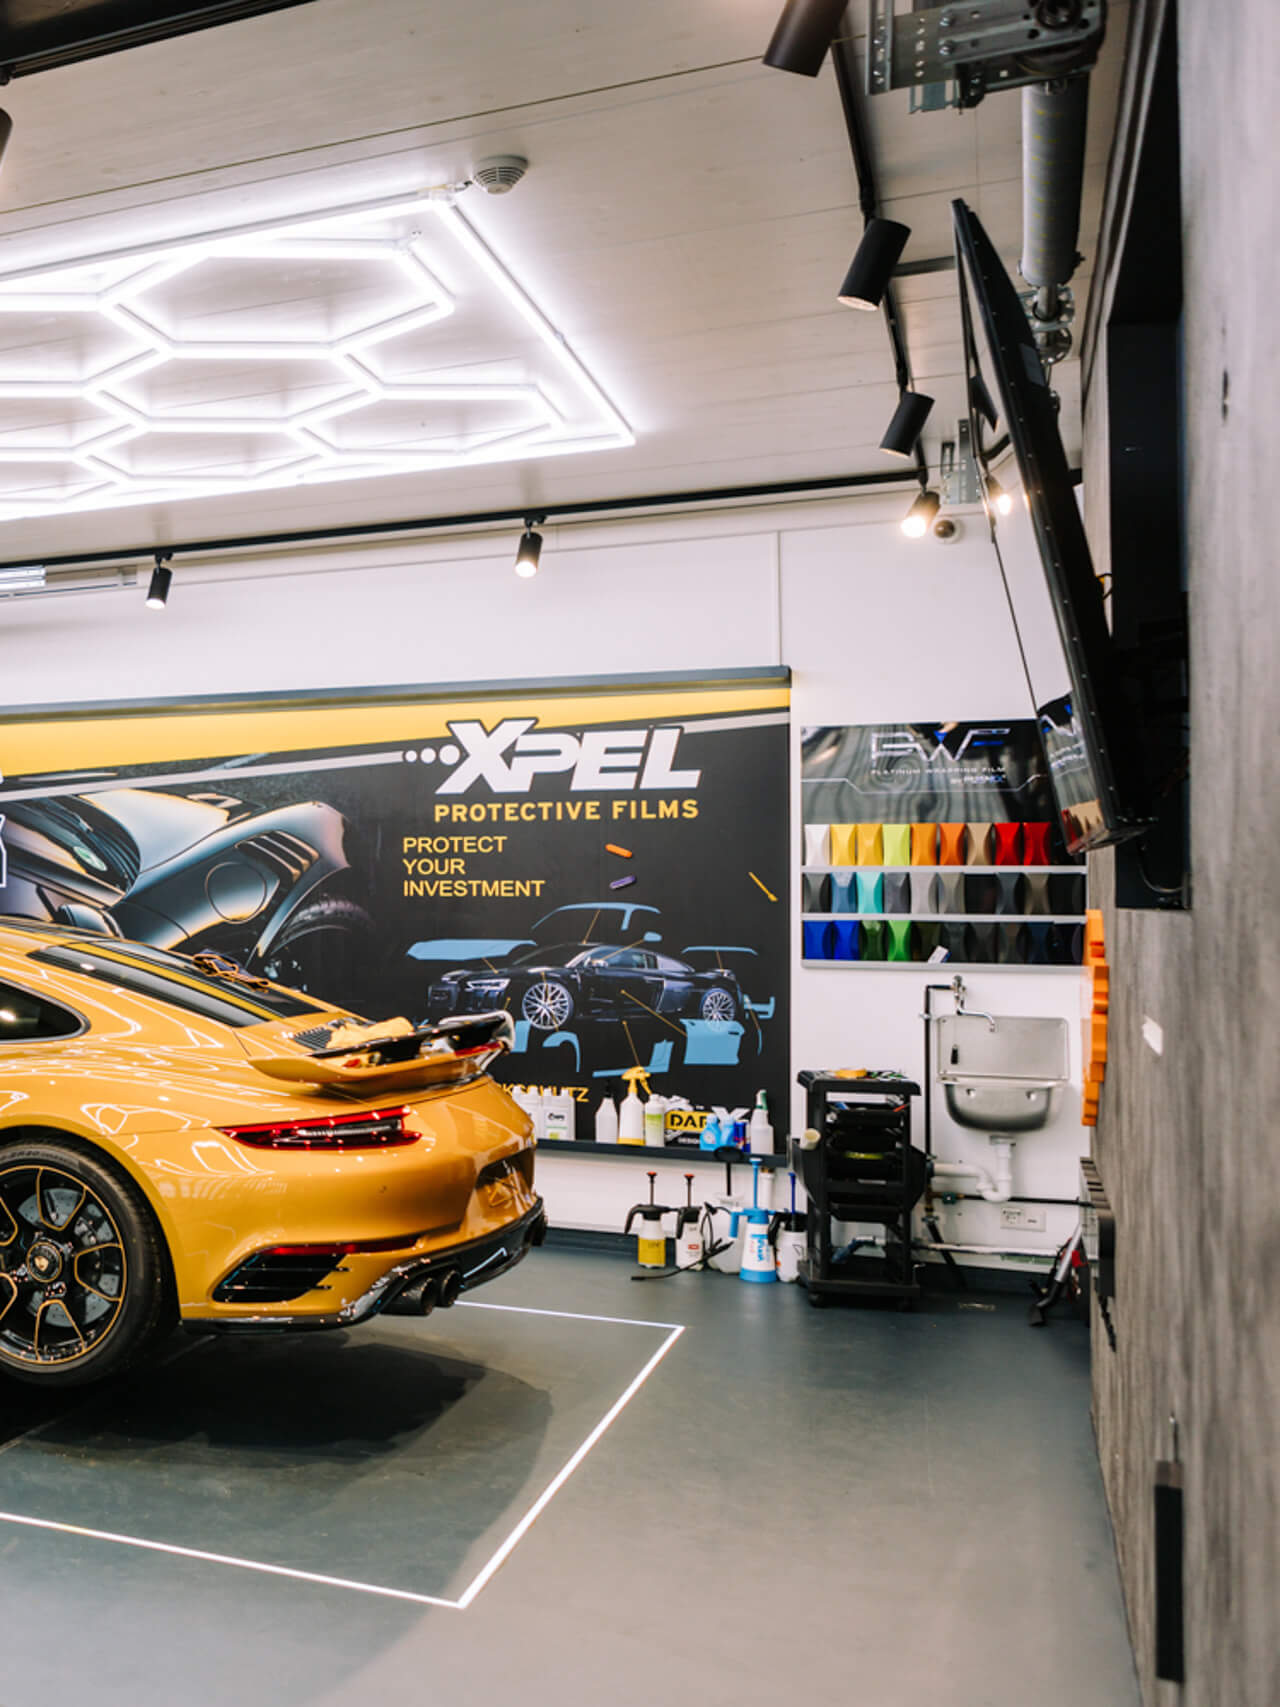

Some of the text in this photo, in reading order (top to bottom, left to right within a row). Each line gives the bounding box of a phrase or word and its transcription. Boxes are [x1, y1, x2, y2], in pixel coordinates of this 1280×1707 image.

[434, 719, 702, 794] XPEL
[434, 799, 699, 822] PROTECTIVE FILMS
[403, 836, 507, 853] PROTECT
[403, 858, 466, 875] YOUR
[403, 880, 546, 897] INVESTMENT
